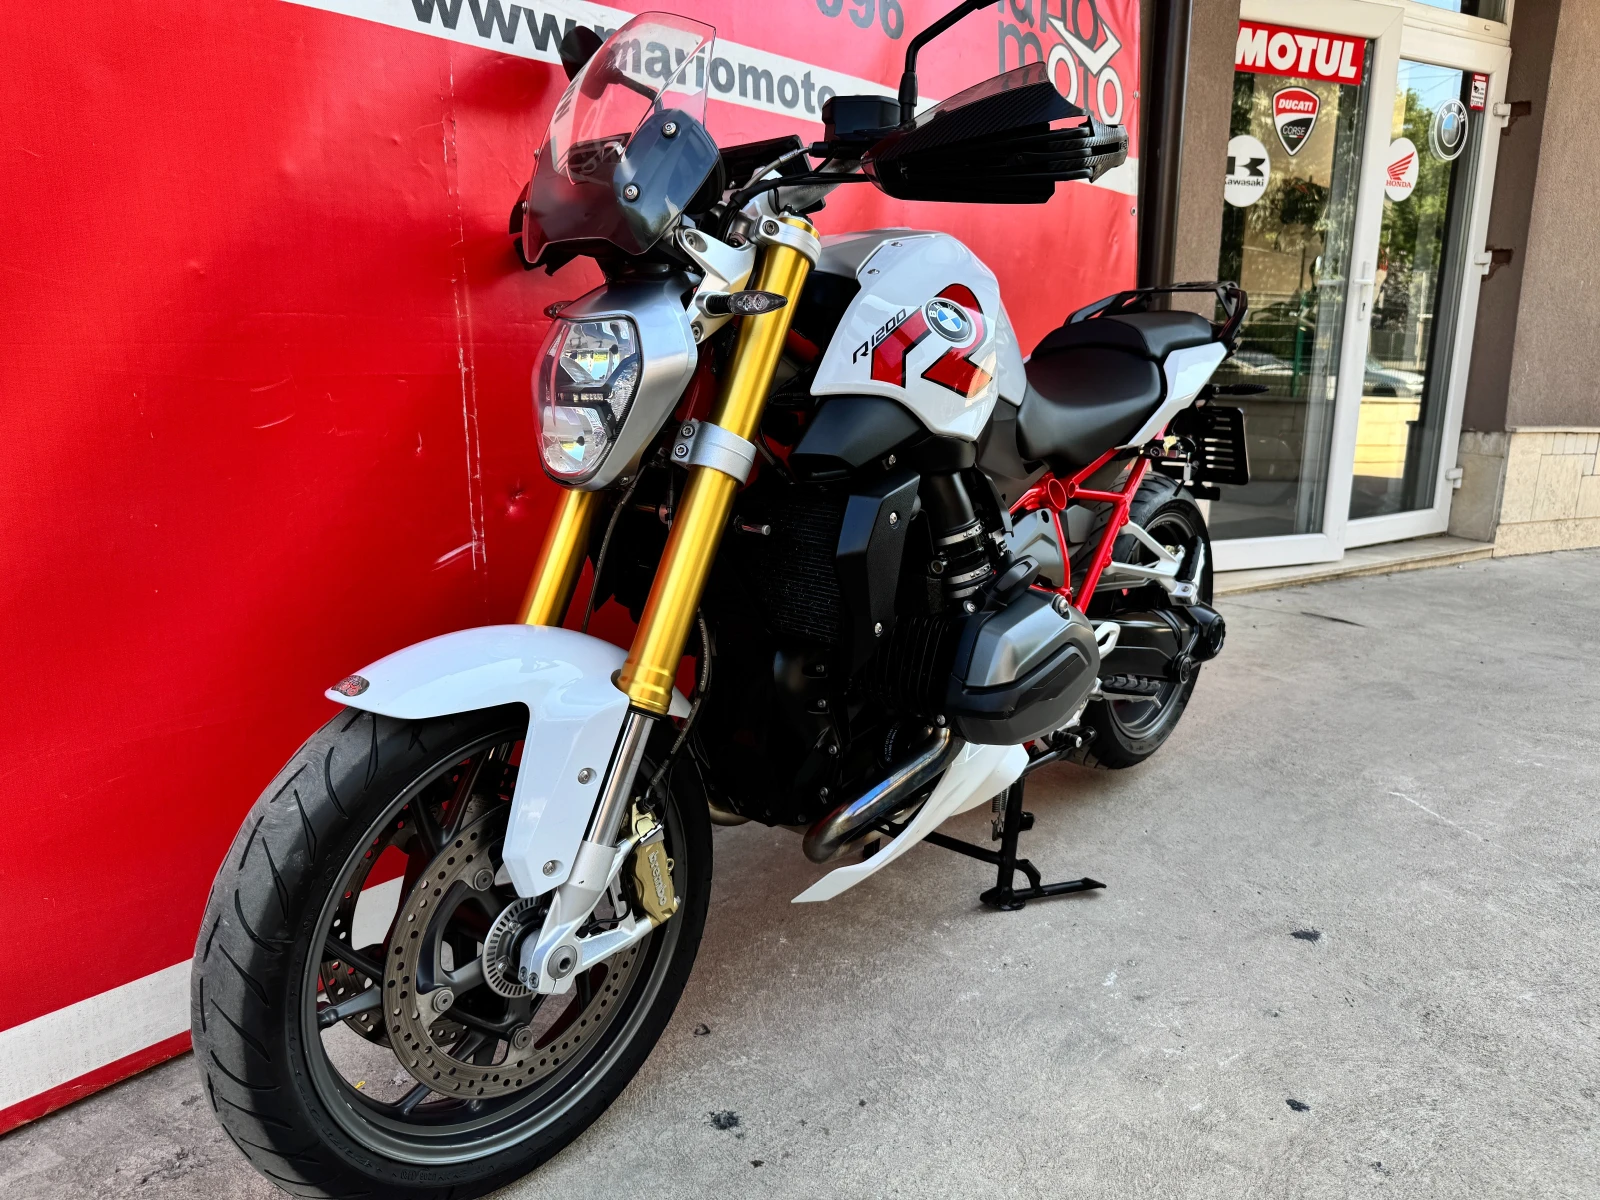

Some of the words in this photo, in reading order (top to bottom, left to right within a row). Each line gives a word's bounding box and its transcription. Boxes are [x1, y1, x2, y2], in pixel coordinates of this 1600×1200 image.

[1235, 27, 1358, 79] MOTUL
[1278, 98, 1314, 112] DUCATI
[1282, 125, 1307, 136] CORSE
[1385, 179, 1412, 189] HONDA
[648, 850, 667, 906] brembo
